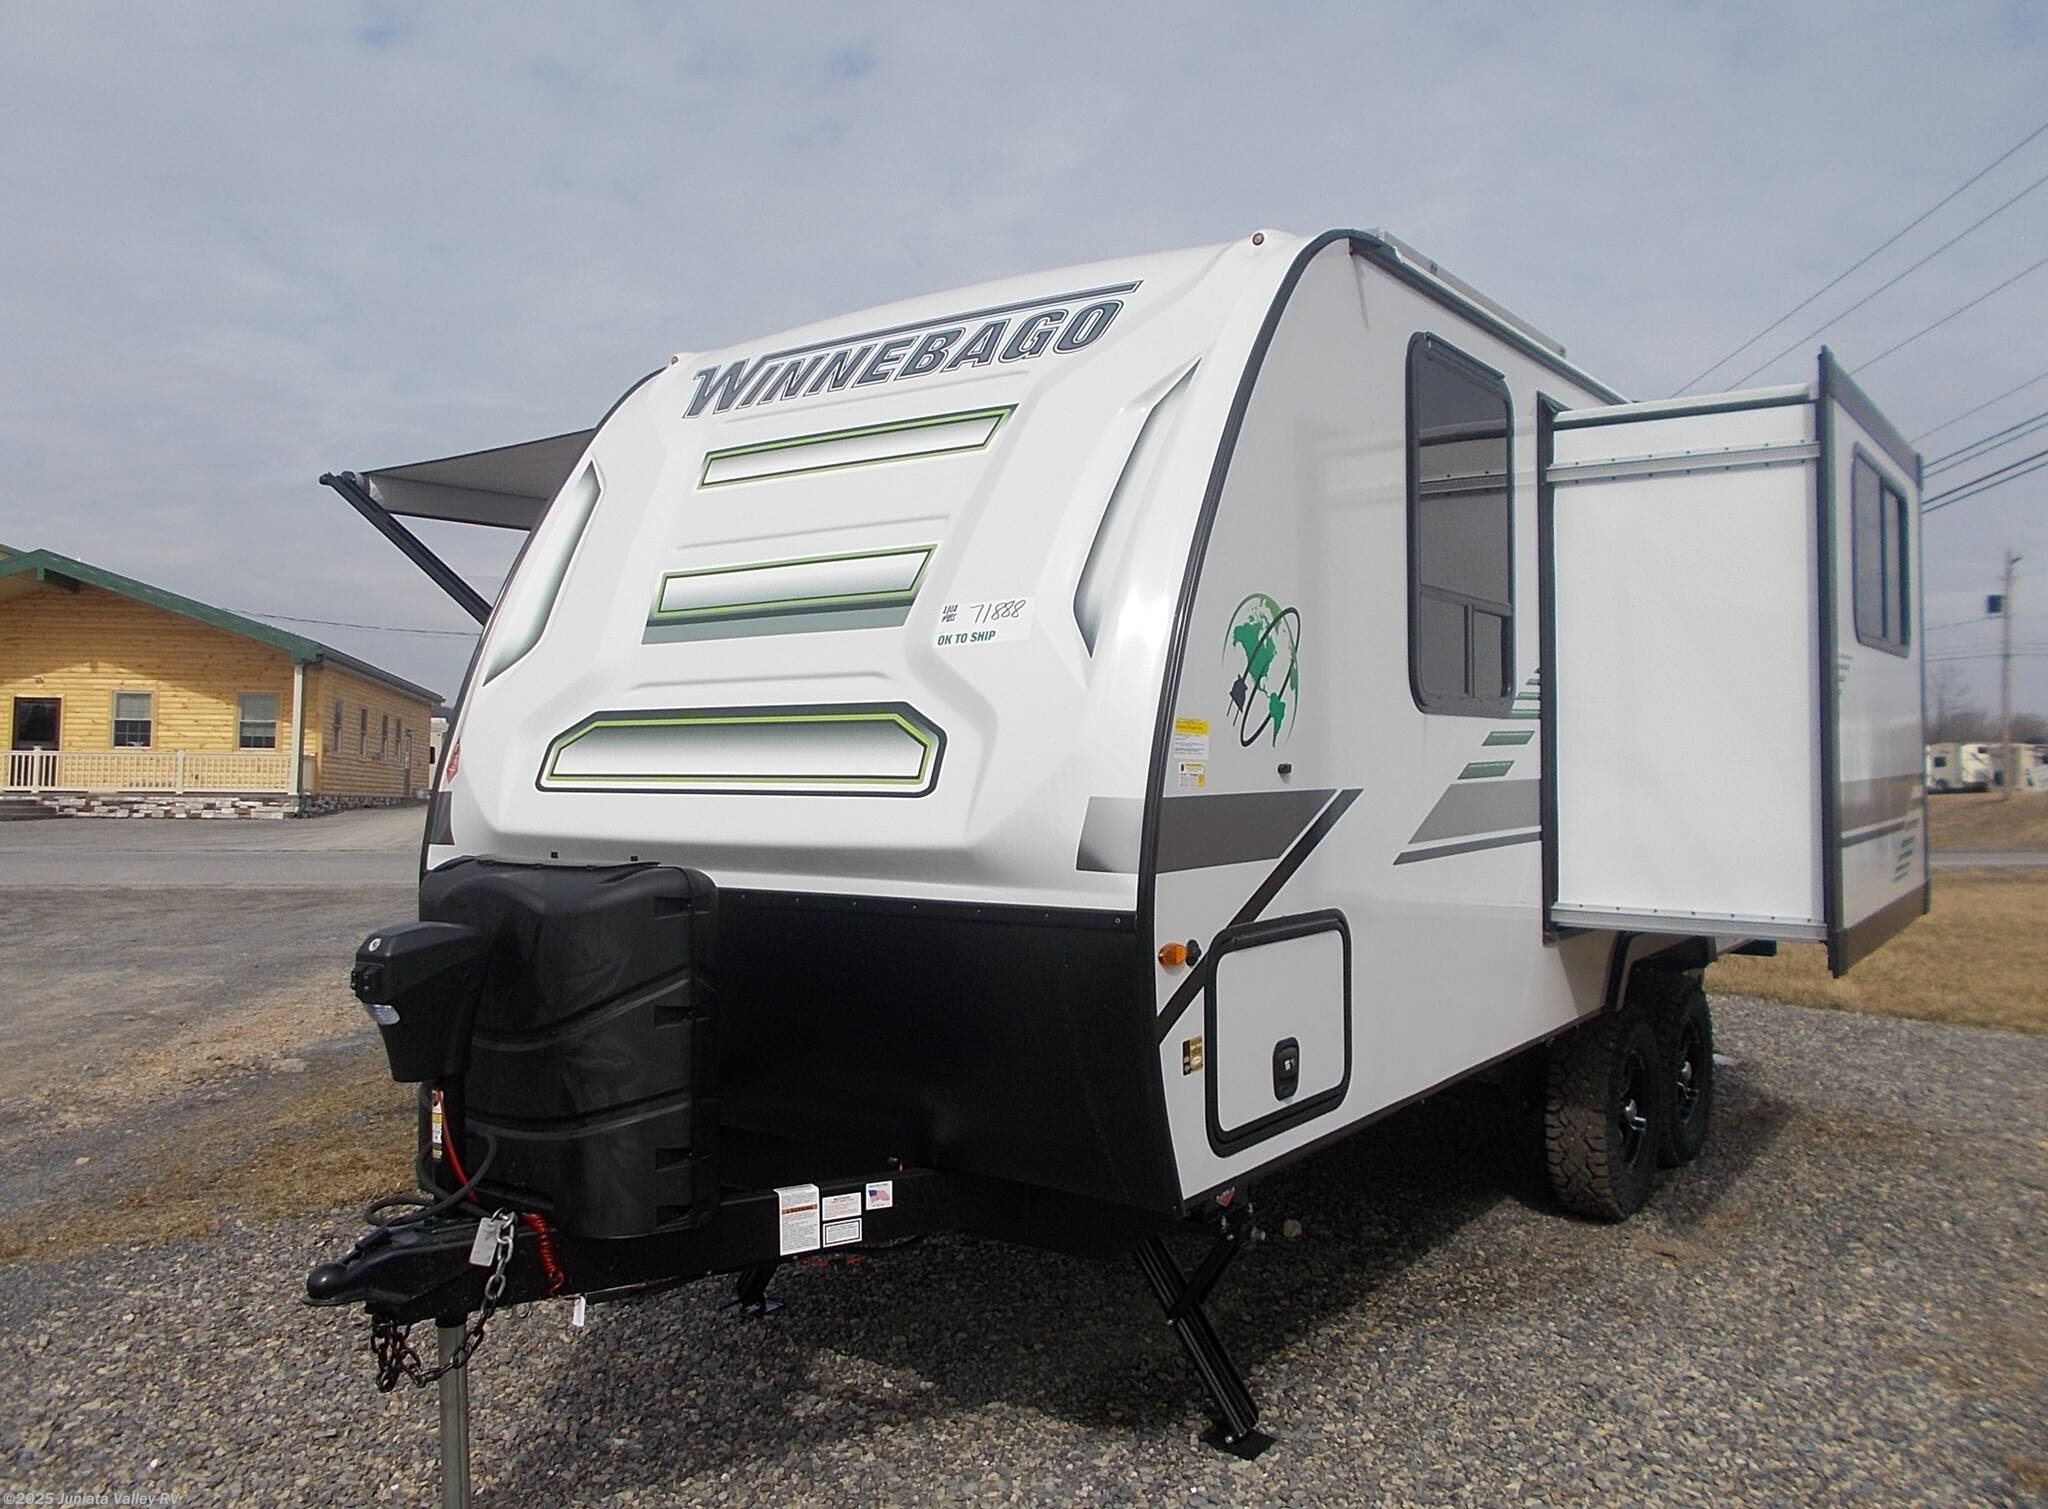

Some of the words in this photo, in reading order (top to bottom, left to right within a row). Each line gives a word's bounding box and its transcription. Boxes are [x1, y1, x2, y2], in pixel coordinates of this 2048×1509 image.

[683, 299, 1124, 419] WINNEBAGO
[969, 599, 1026, 624] 71888
[937, 634, 953, 646] OK
[955, 632, 968, 644] TO
[970, 630, 996, 643] SHIP
